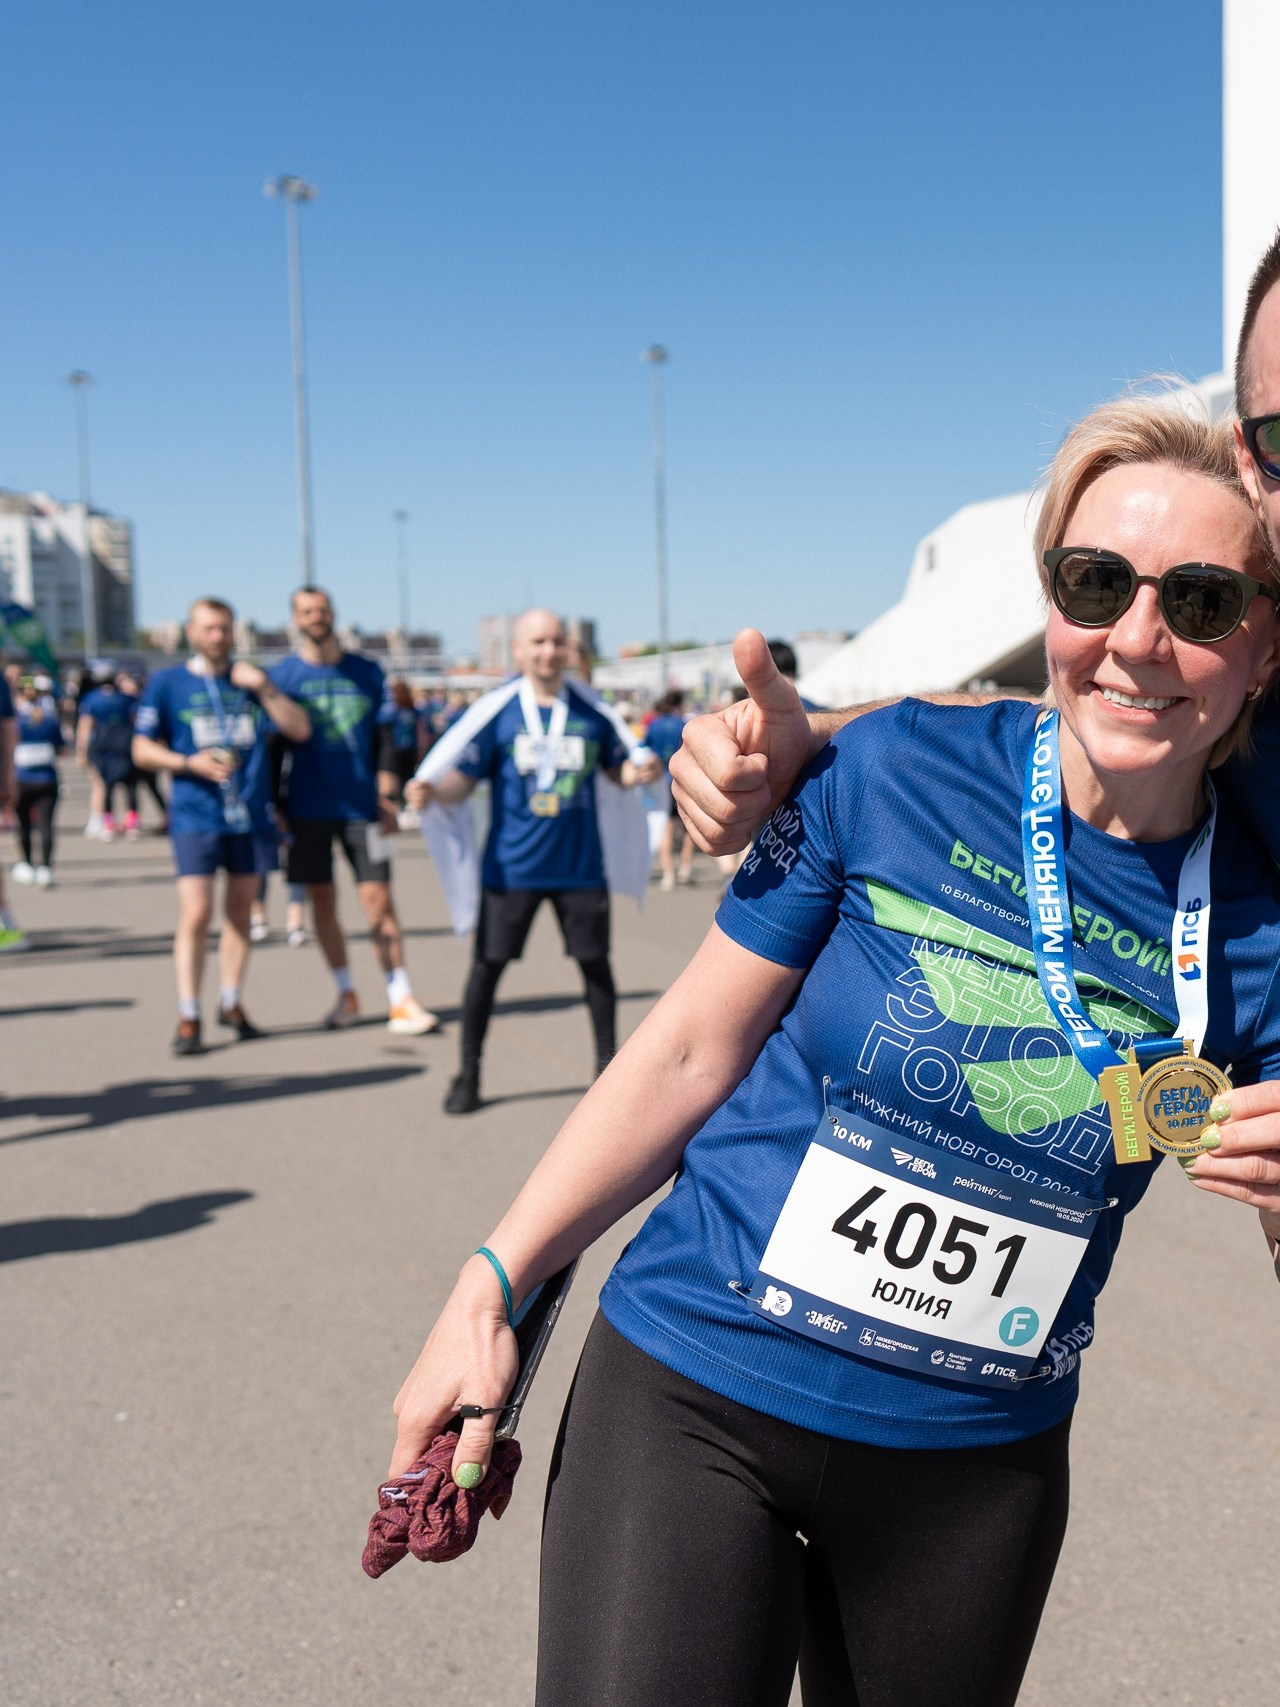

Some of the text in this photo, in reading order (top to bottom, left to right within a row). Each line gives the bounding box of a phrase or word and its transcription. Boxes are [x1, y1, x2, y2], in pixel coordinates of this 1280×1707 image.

[940, 883, 952, 894] 10
[1031, 728, 1101, 1049] ГЕРОИ МЕНЯЮТ ЭТОТ
[1181, 897, 1202, 947] ПСБ
[1073, 903, 1172, 976] ЕРОЙ!
[857, 1020, 1112, 1175] ГОРОД
[1115, 1071, 1139, 1158] БЕГИ, ГЕРОЙ!
[1166, 1115, 1205, 1129] 10 ЛЕТ
[832, 1125, 848, 1139] 10
[852, 1088, 931, 1141] НИЖНИЙ
[934, 1129, 1039, 1184] НОВГОРОД
[1147, 1132, 1178, 1153] НИЖНИЙ
[1030, 1198, 1086, 1219] НИЖНИЙ НОВГОРОД
[831, 1185, 1027, 1297] 4051
[871, 1278, 953, 1320] ЮЛИЯ
[1008, 1313, 1031, 1340] F
[1061, 1321, 1094, 1349] ПСБ
[874, 1341, 897, 1352] ОБЛАСТЬ
[876, 1335, 919, 1352] НИЖЕГОРОДСКАЯ
[994, 1366, 1017, 1378] ПСБ
